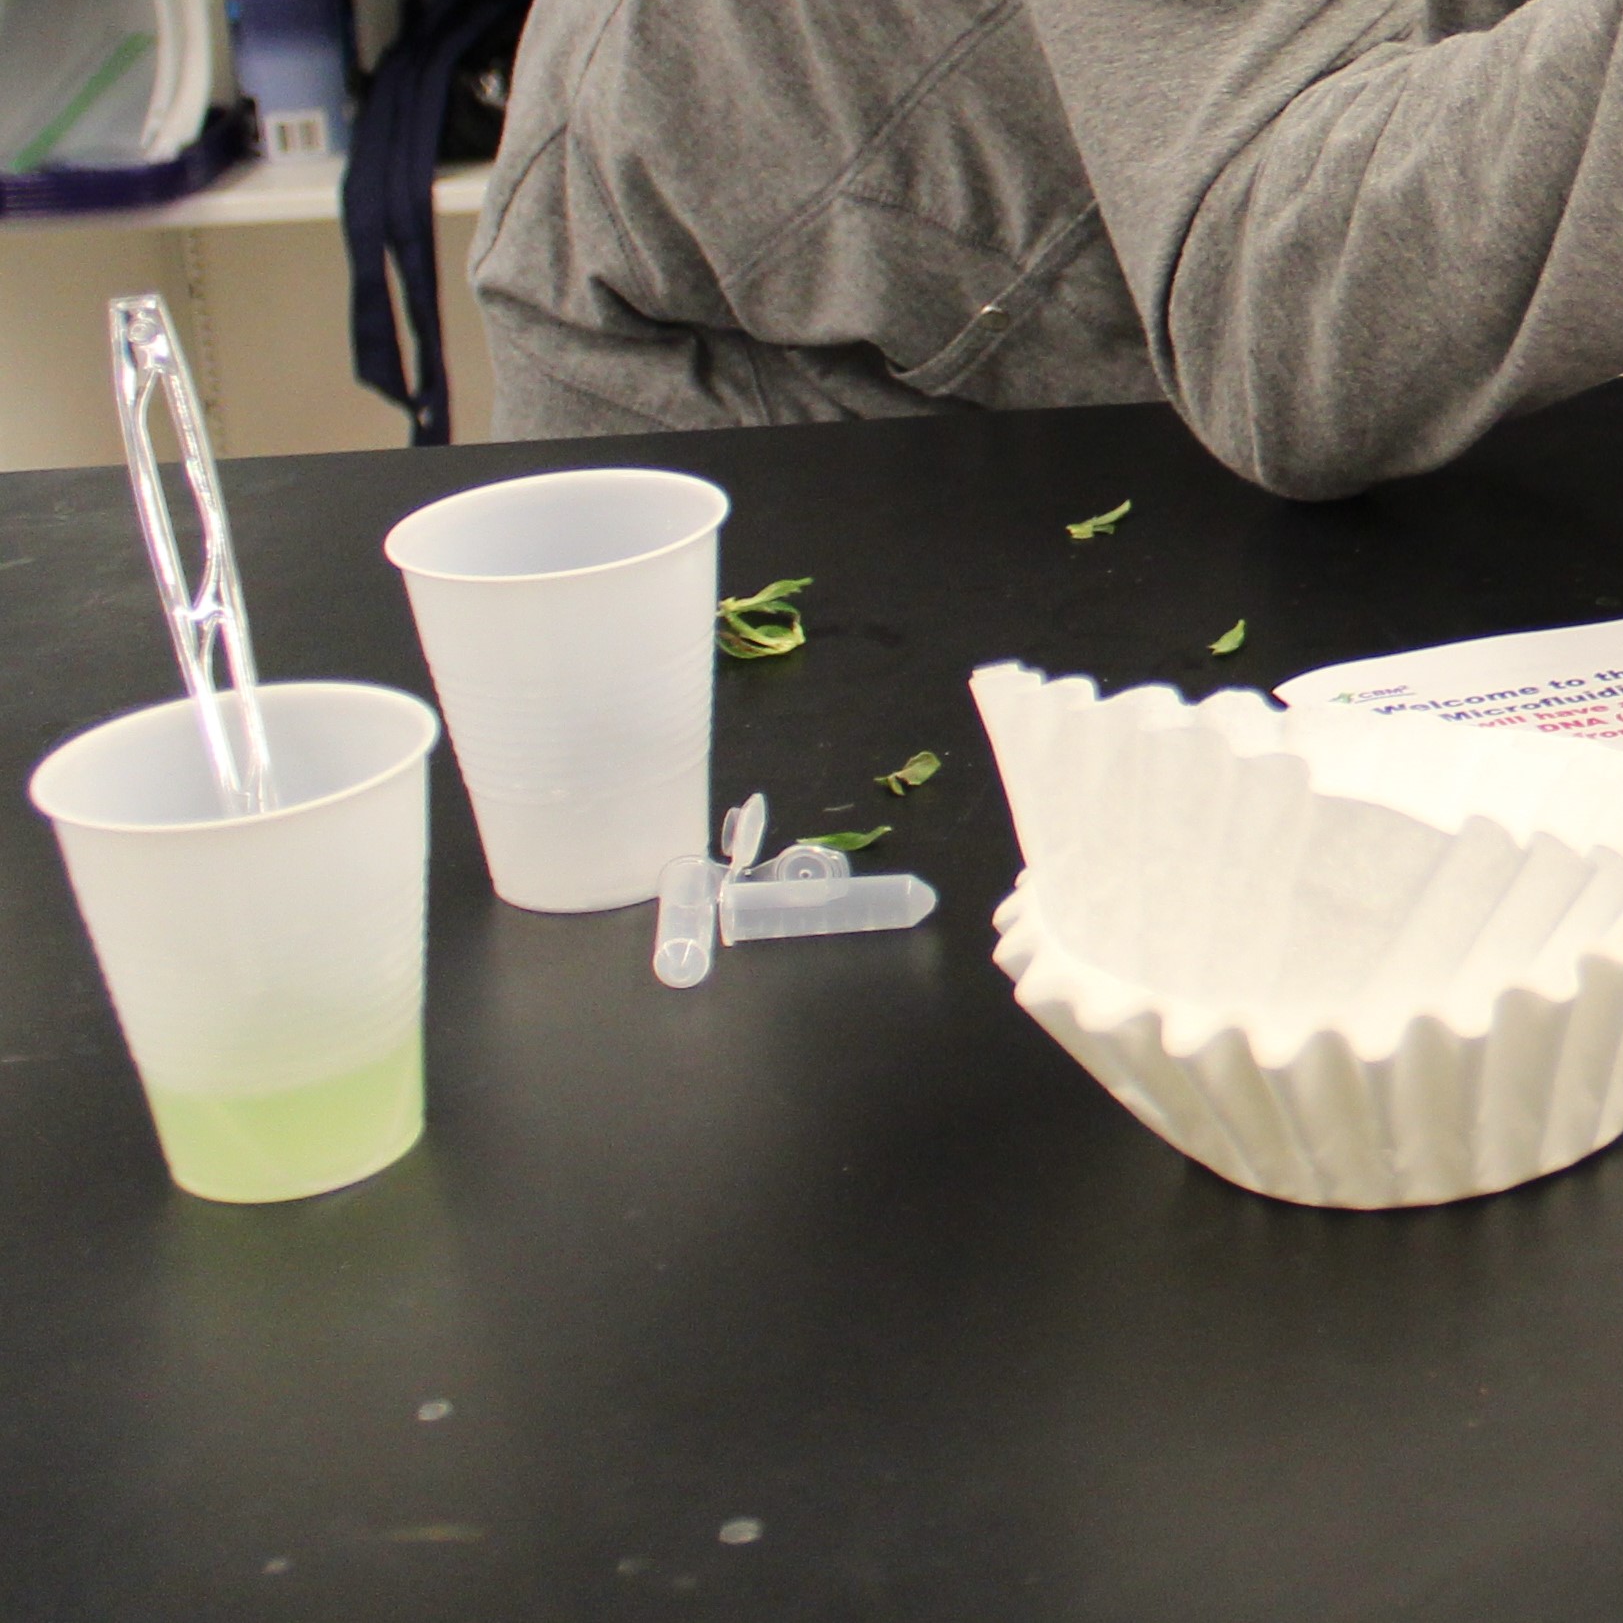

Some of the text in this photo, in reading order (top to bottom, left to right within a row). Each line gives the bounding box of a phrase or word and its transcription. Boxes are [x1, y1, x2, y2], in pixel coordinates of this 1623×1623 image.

[1371, 684, 1541, 716] Welcome
[1548, 677, 1587, 690] to
[1533, 704, 1610, 721] have
[1537, 716, 1611, 733] DNA
